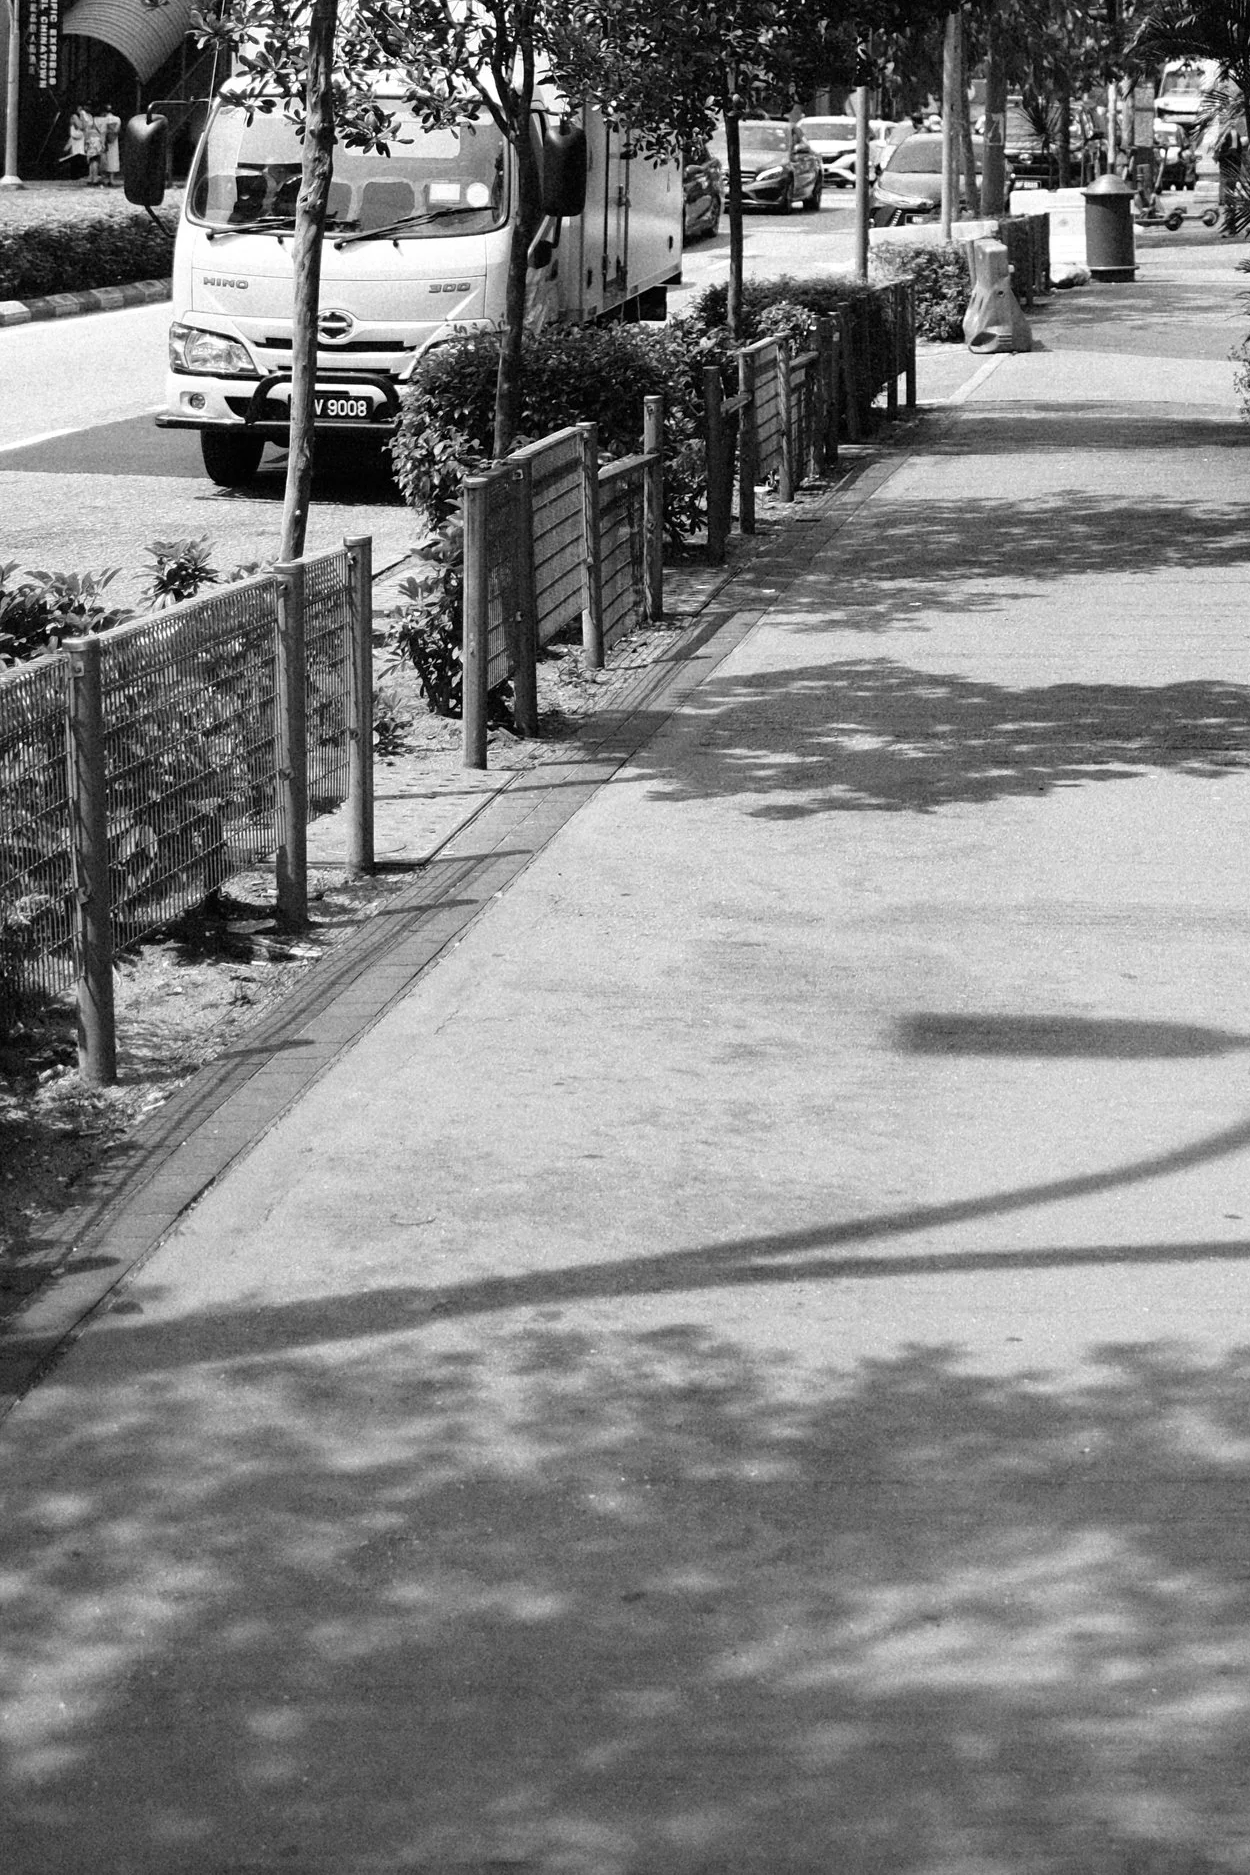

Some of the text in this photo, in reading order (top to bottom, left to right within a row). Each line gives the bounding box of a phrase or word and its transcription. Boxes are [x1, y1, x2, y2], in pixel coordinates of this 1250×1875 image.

[38, 15, 48, 89] CHINATOWN
[48, 28, 57, 86] EXPRESS
[203, 276, 249, 290] HINO
[428, 282, 471, 294] 300
[327, 399, 367, 417] 9008
